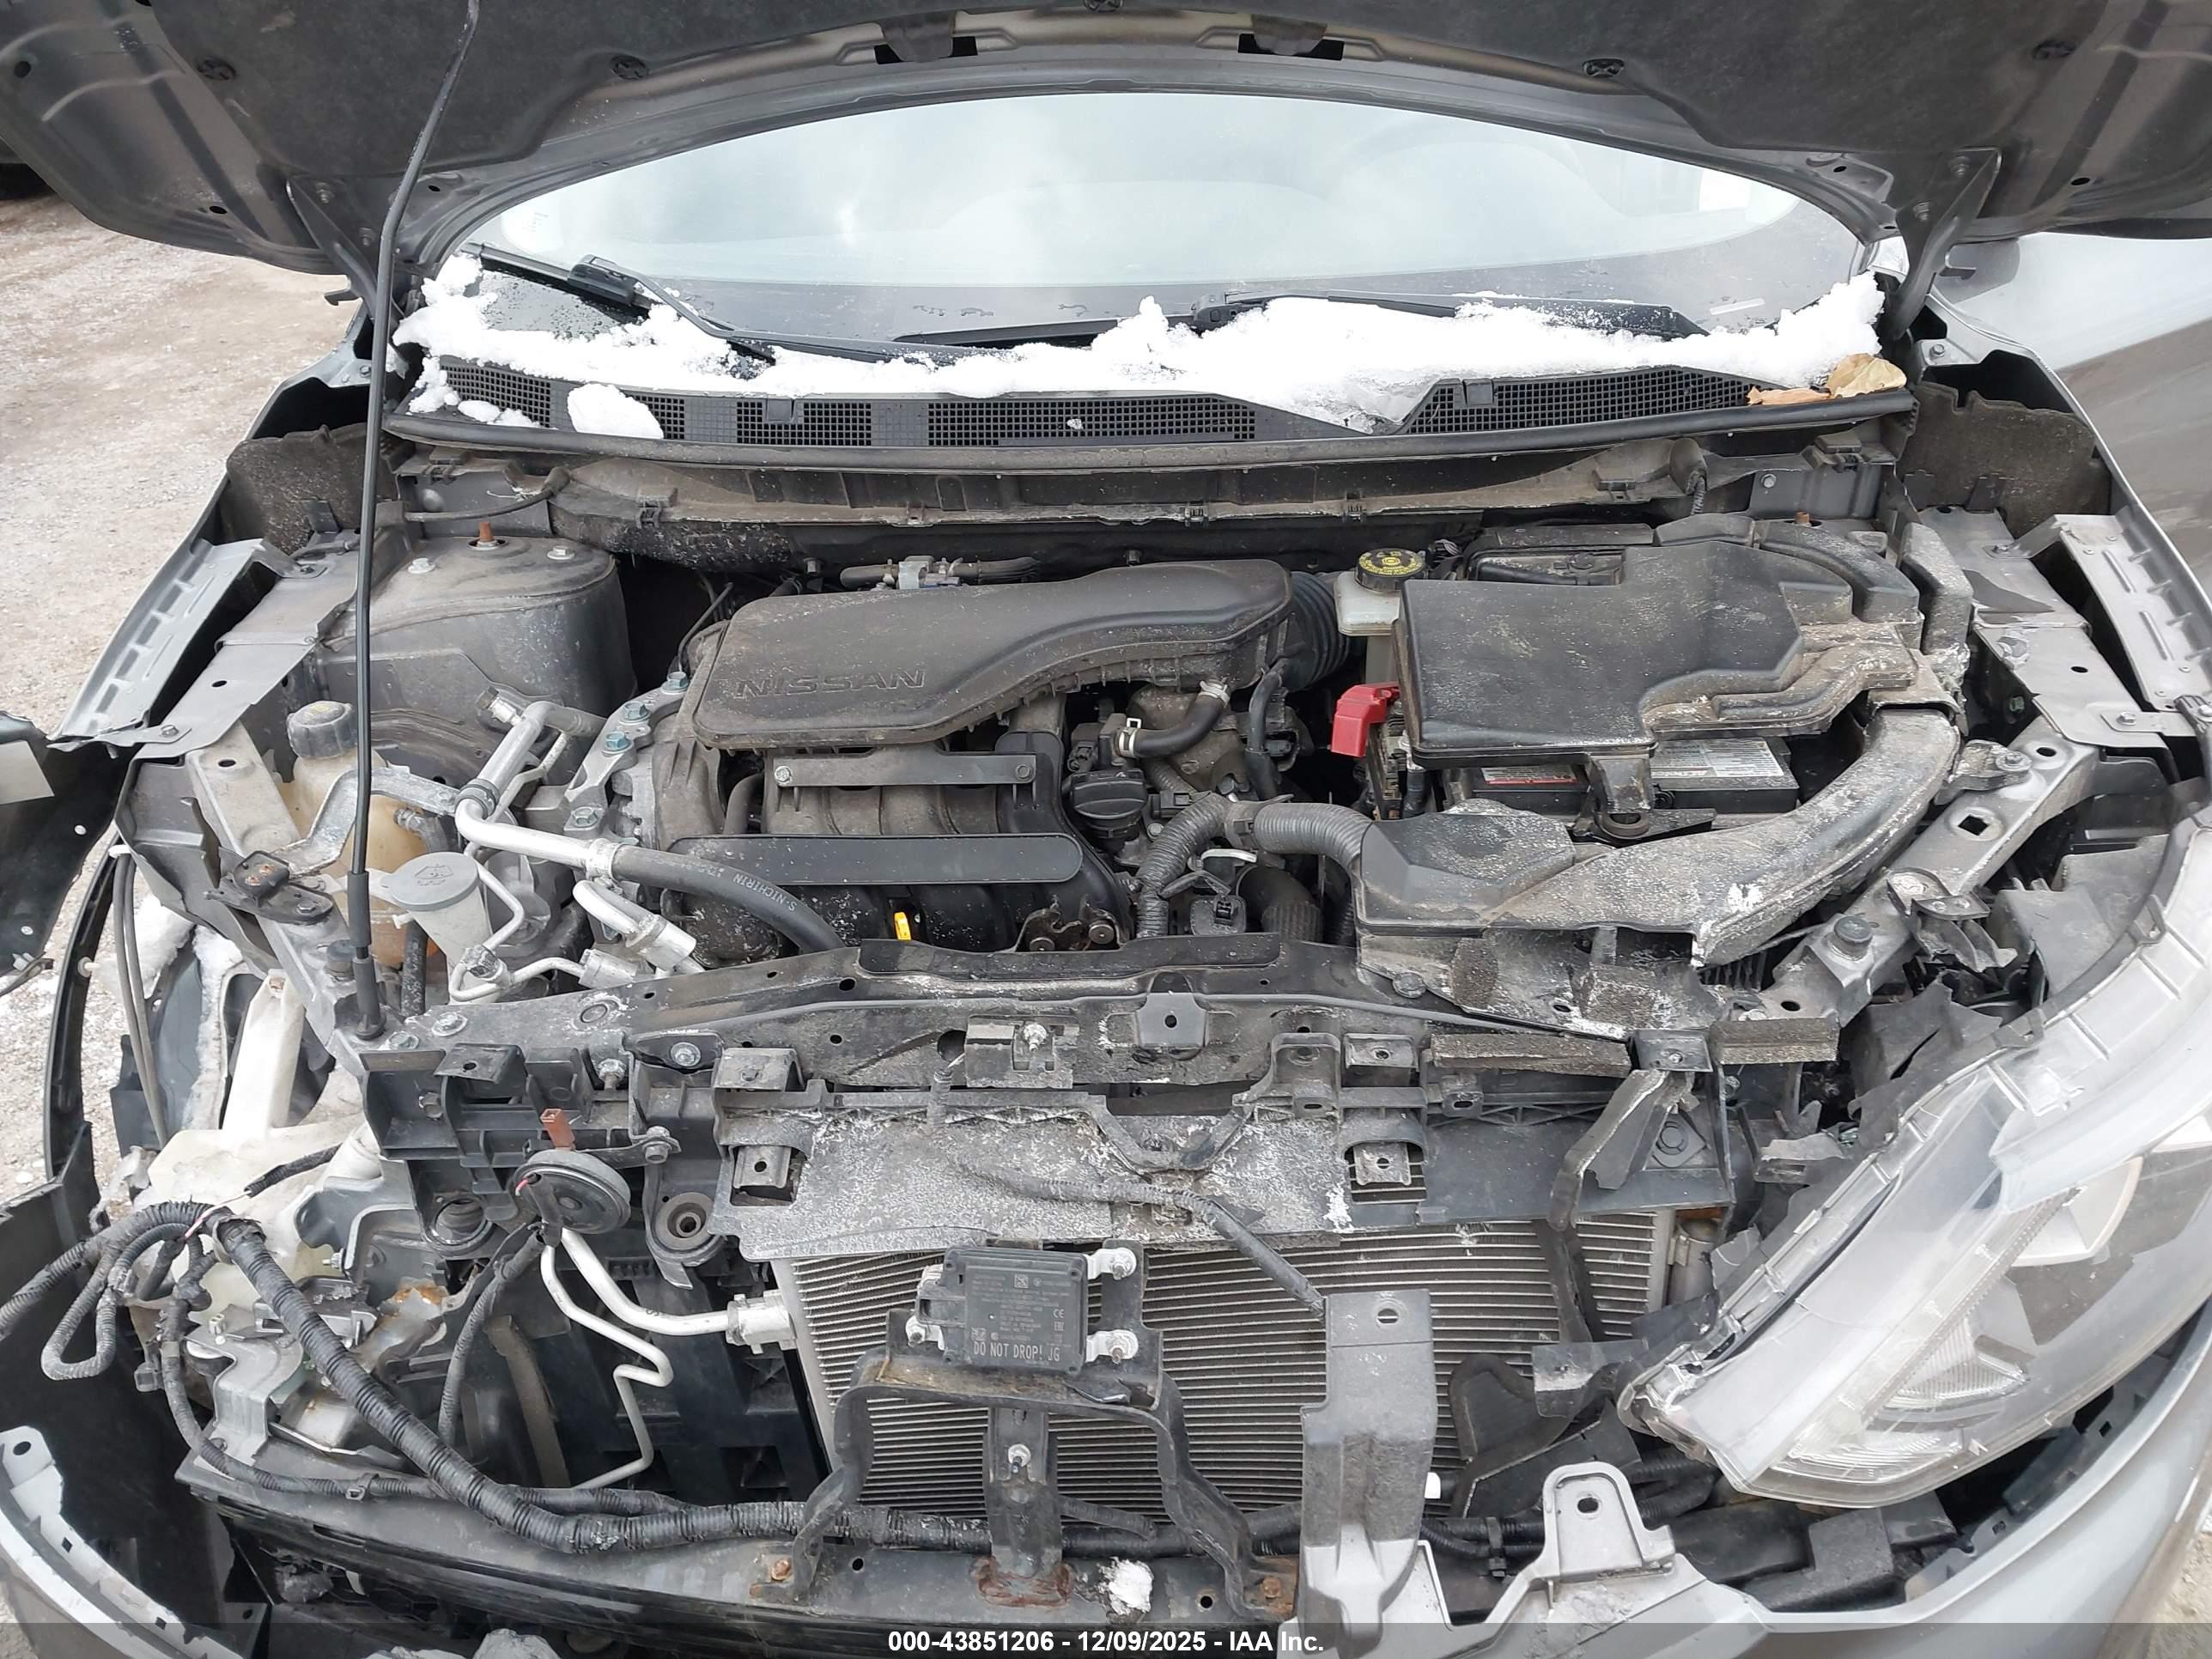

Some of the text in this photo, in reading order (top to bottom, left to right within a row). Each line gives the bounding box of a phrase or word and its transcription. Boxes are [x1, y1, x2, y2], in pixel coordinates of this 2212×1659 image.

[731, 669, 927, 701] NISSAN
[1053, 1308, 1065, 1319] CE
[974, 1340, 987, 1357] DO
[990, 1341, 1010, 1358] NOT
[1013, 1344, 1042, 1361] DROP!
